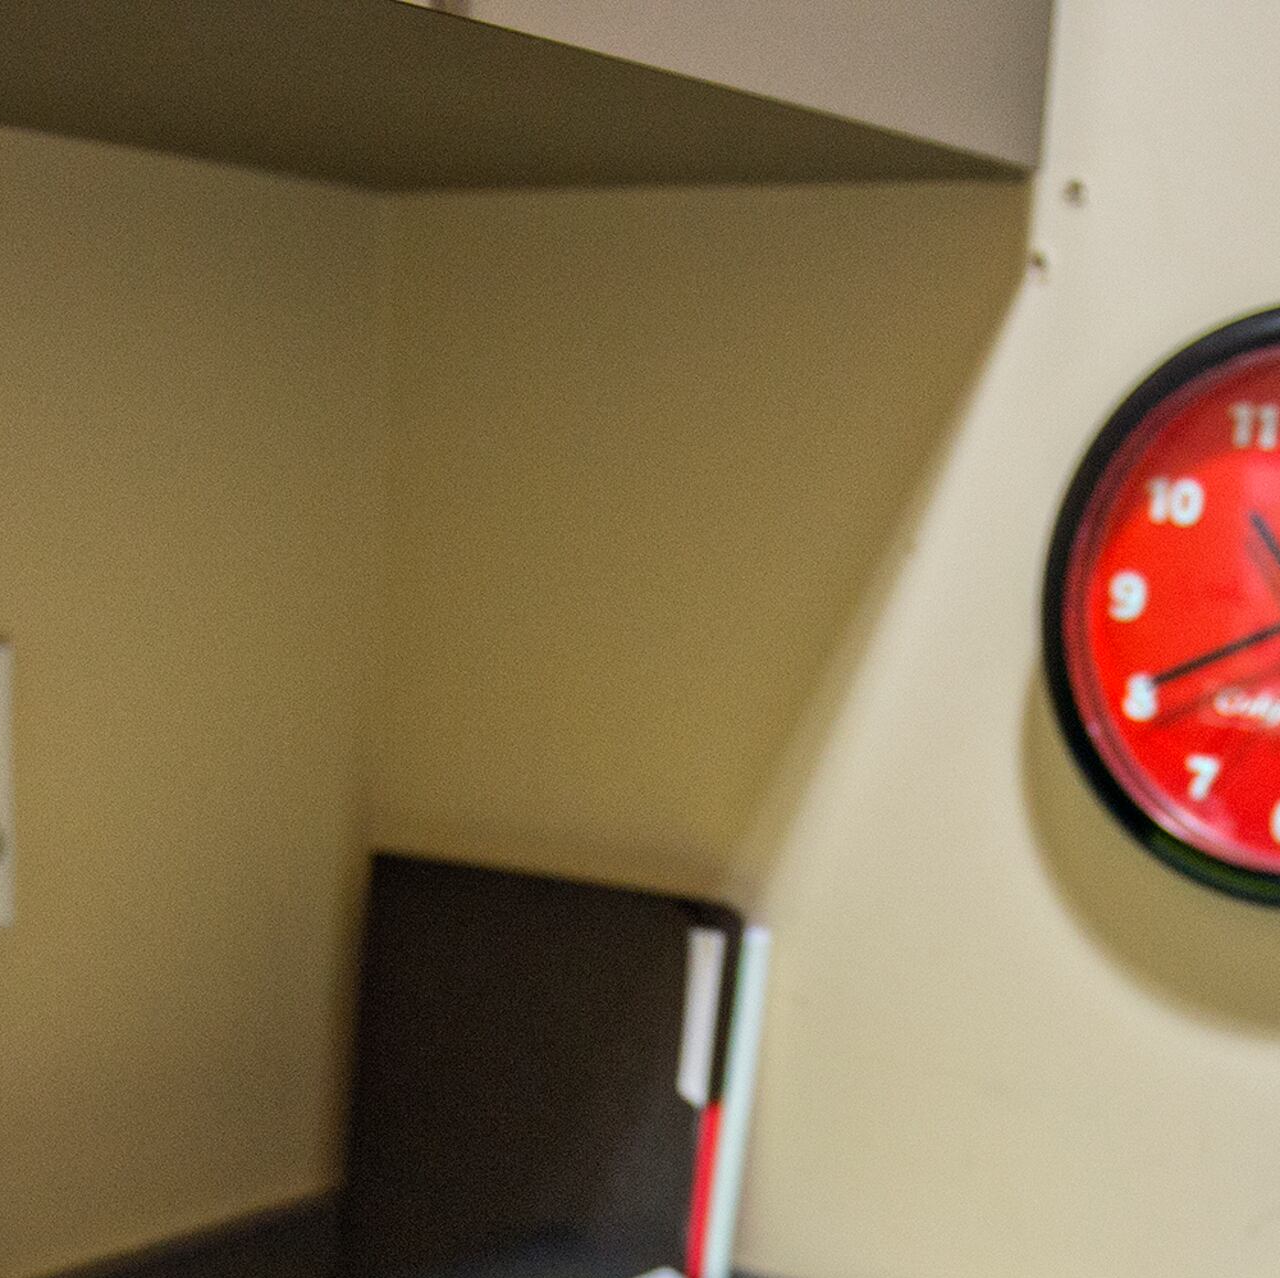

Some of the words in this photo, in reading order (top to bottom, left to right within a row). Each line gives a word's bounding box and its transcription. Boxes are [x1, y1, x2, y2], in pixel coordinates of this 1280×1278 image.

[1229, 402, 1280, 451] 11
[1147, 475, 1206, 528] 10
[1108, 569, 1148, 622] 9
[1122, 672, 1159, 722] 8
[1185, 754, 1219, 800] 7
